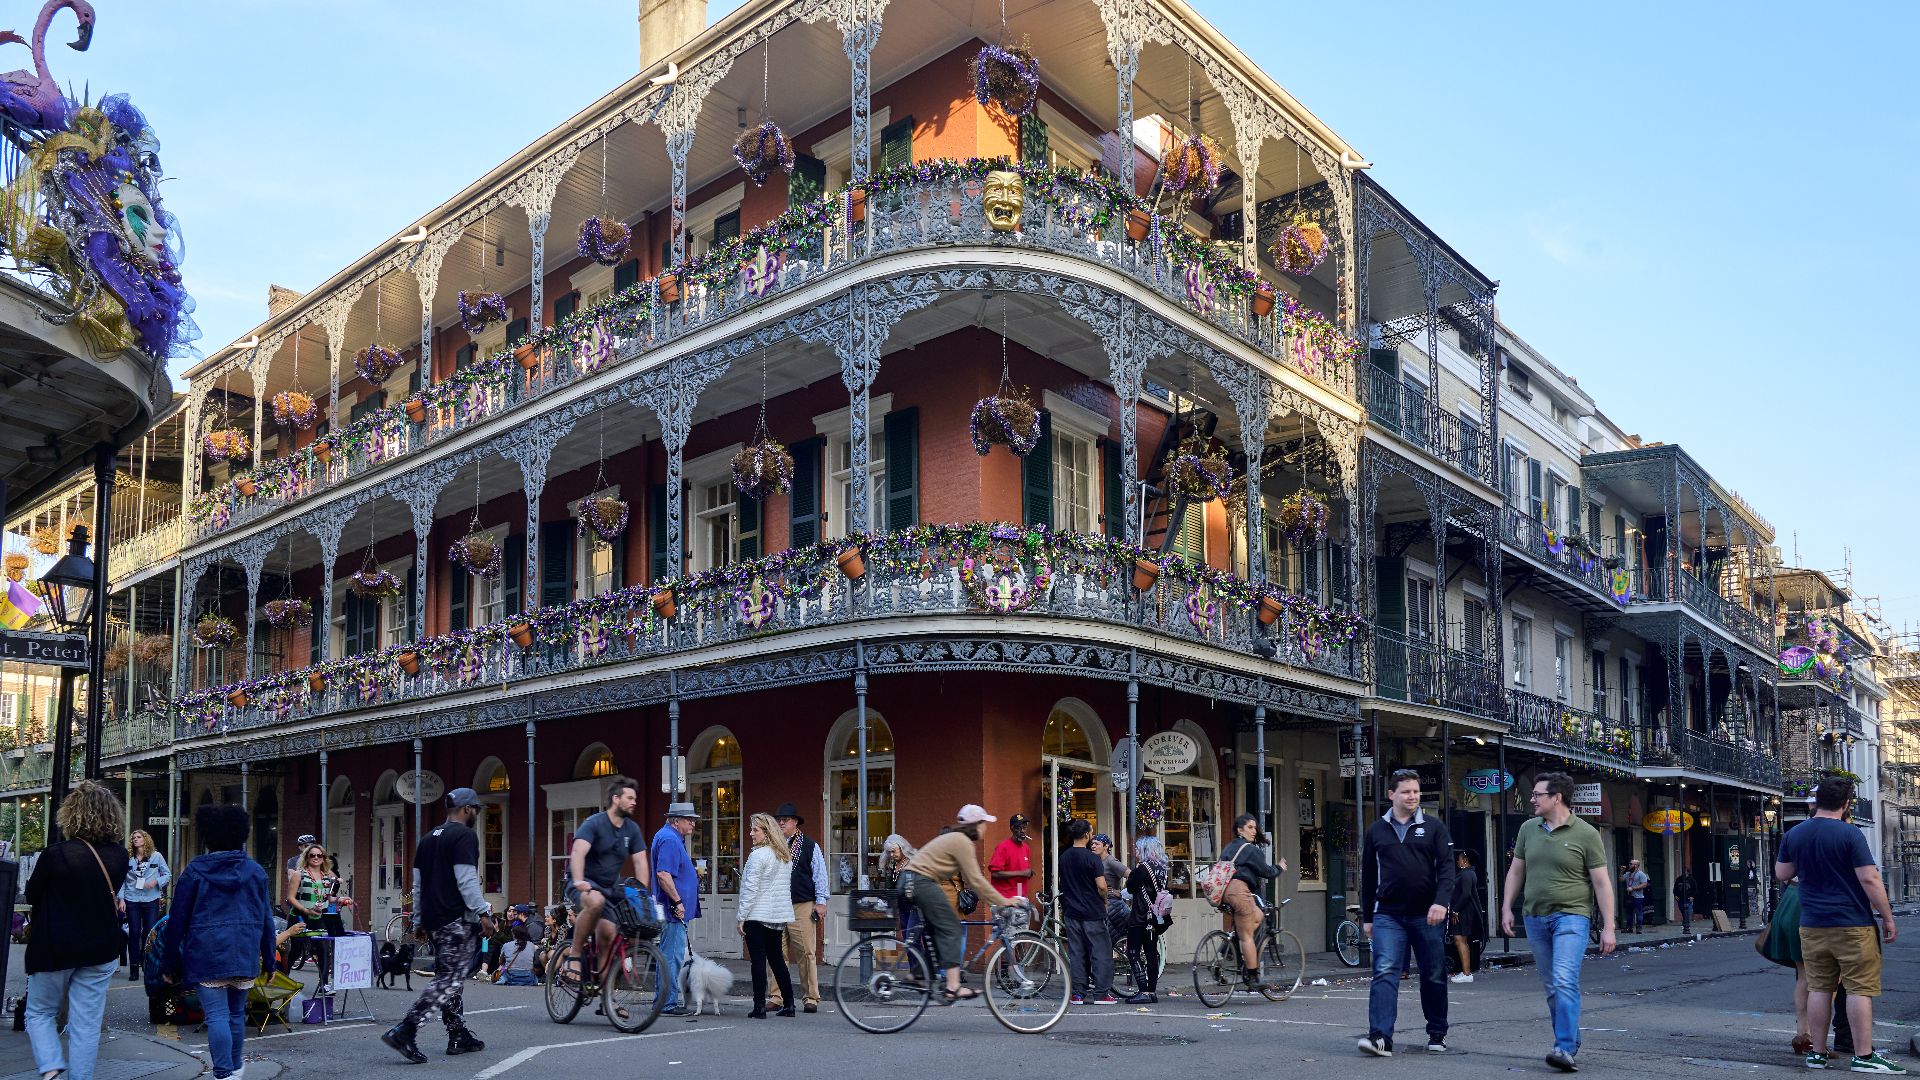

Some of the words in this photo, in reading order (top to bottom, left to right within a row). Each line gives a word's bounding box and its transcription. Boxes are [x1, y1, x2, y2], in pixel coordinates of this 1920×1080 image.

[0, 642, 16, 654] t.
[27, 641, 81, 659] Peter
[1148, 735, 1190, 750] FOREVER
[339, 962, 369, 985] PAINT
